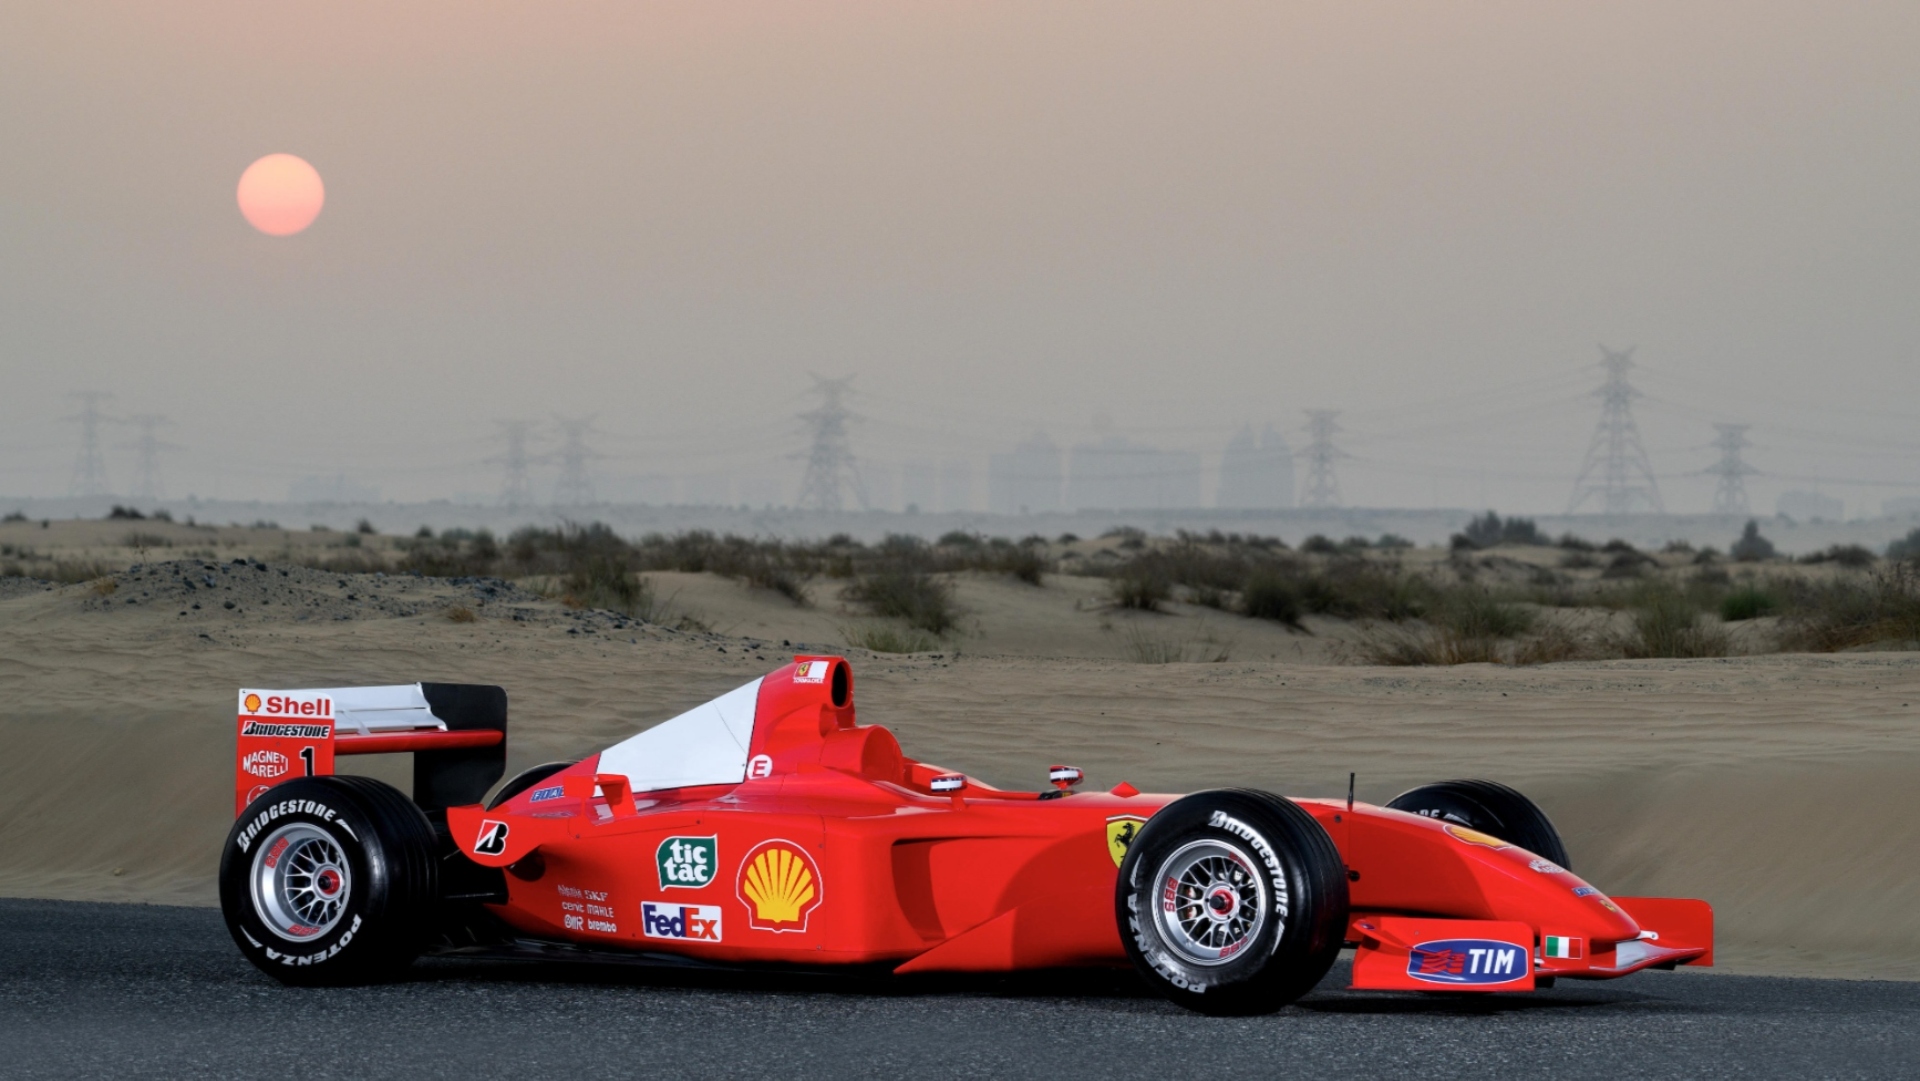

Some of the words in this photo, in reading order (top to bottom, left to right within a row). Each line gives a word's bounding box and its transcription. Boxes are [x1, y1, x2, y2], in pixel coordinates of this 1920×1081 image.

[266, 696, 330, 716] Shell
[242, 721, 331, 738] BRIDGESTONE
[300, 747, 315, 777] 1
[752, 760, 768, 777] E
[532, 788, 563, 800] FIA
[237, 799, 336, 853] BRIDGESTONE
[474, 819, 509, 856] B
[669, 839, 707, 864] tic
[1208, 810, 1288, 917] BRIDGESTONE
[663, 857, 708, 882] tac
[588, 918, 617, 932] brembo
[643, 904, 719, 940] FedEx
[266, 914, 362, 966] POTENZA
[1128, 893, 1207, 994] POTENZA
[1469, 949, 1515, 974] TIM
